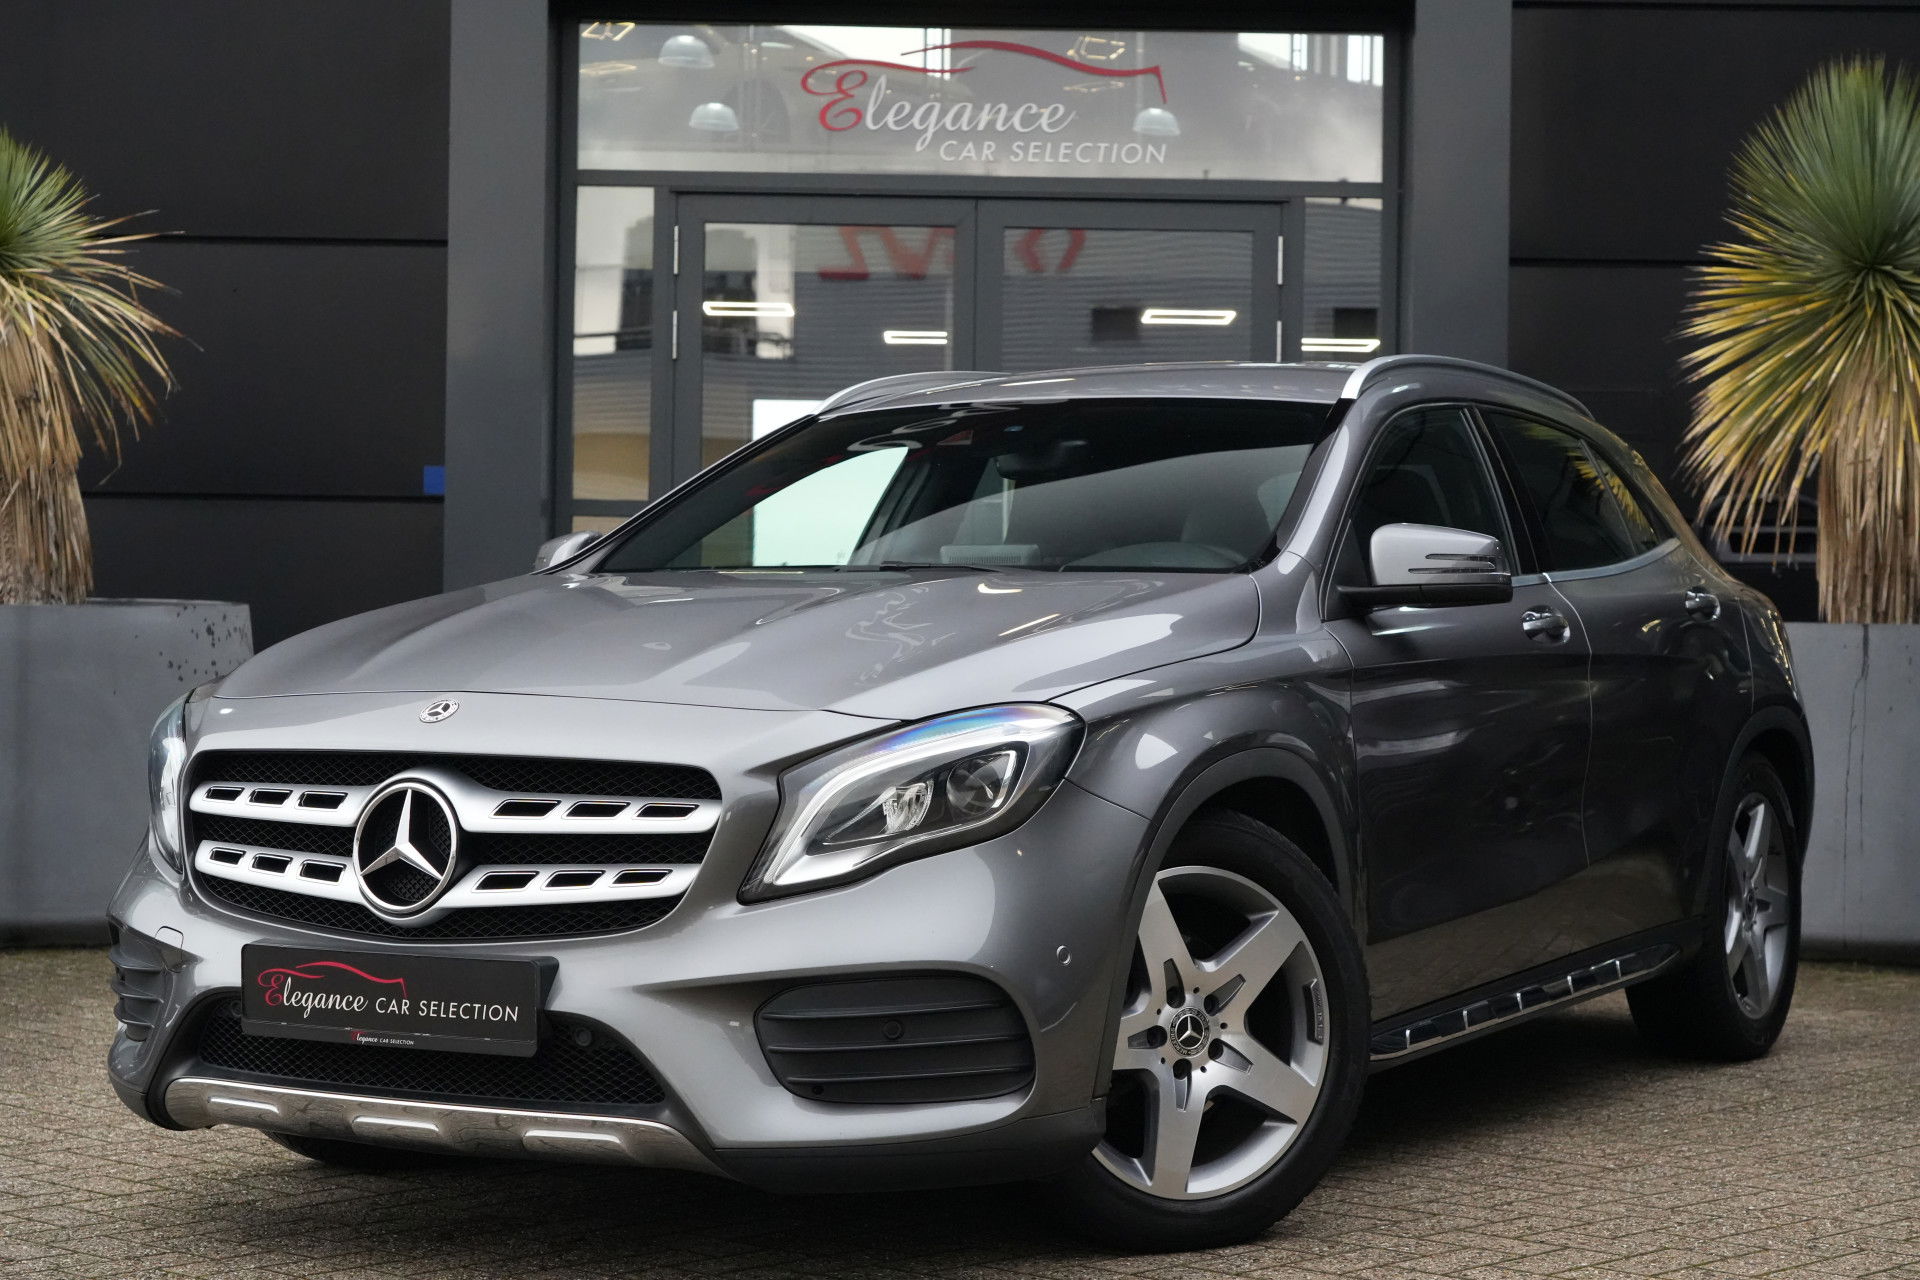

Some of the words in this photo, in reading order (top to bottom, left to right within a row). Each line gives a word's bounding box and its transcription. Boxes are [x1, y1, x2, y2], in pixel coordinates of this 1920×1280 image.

[802, 59, 1075, 151] Elegance
[939, 141, 996, 161] CAR
[1010, 141, 1166, 164] SELECTION
[258, 968, 368, 1018] Elegance
[375, 997, 409, 1015] CAR
[419, 1000, 519, 1021] SELECTION
[352, 1031, 377, 1044] Elegance
